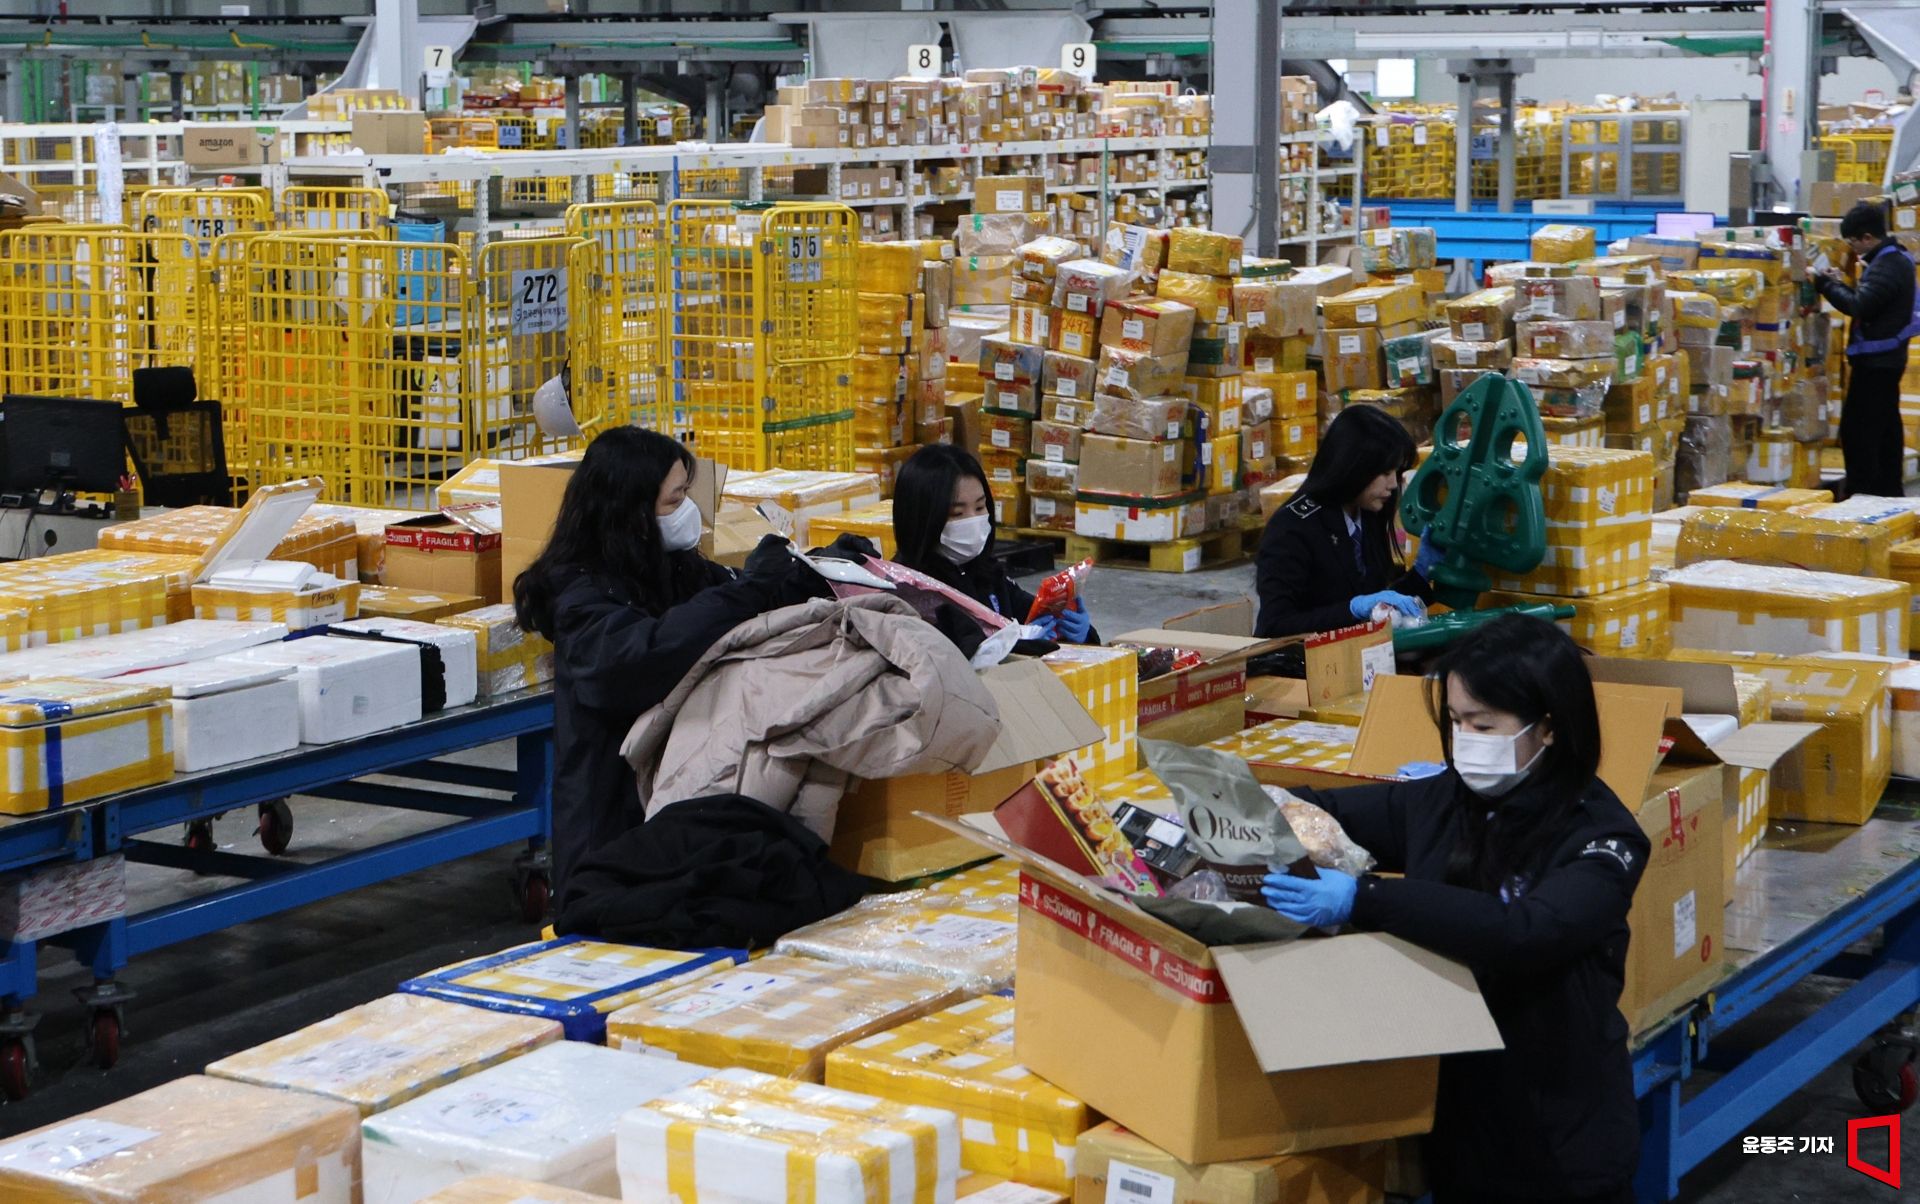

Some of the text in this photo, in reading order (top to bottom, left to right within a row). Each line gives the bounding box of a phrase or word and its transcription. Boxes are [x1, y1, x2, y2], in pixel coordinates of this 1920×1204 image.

[432, 48, 444, 68] 7
[919, 48, 931, 69] 8
[1072, 47, 1086, 68] 9
[199, 138, 234, 147] amazon
[523, 274, 557, 304] 272
[425, 536, 459, 546] FRAGILE
[1100, 925, 1144, 961] FRAGILE
[1163, 962, 1215, 995] ระวังแตก
